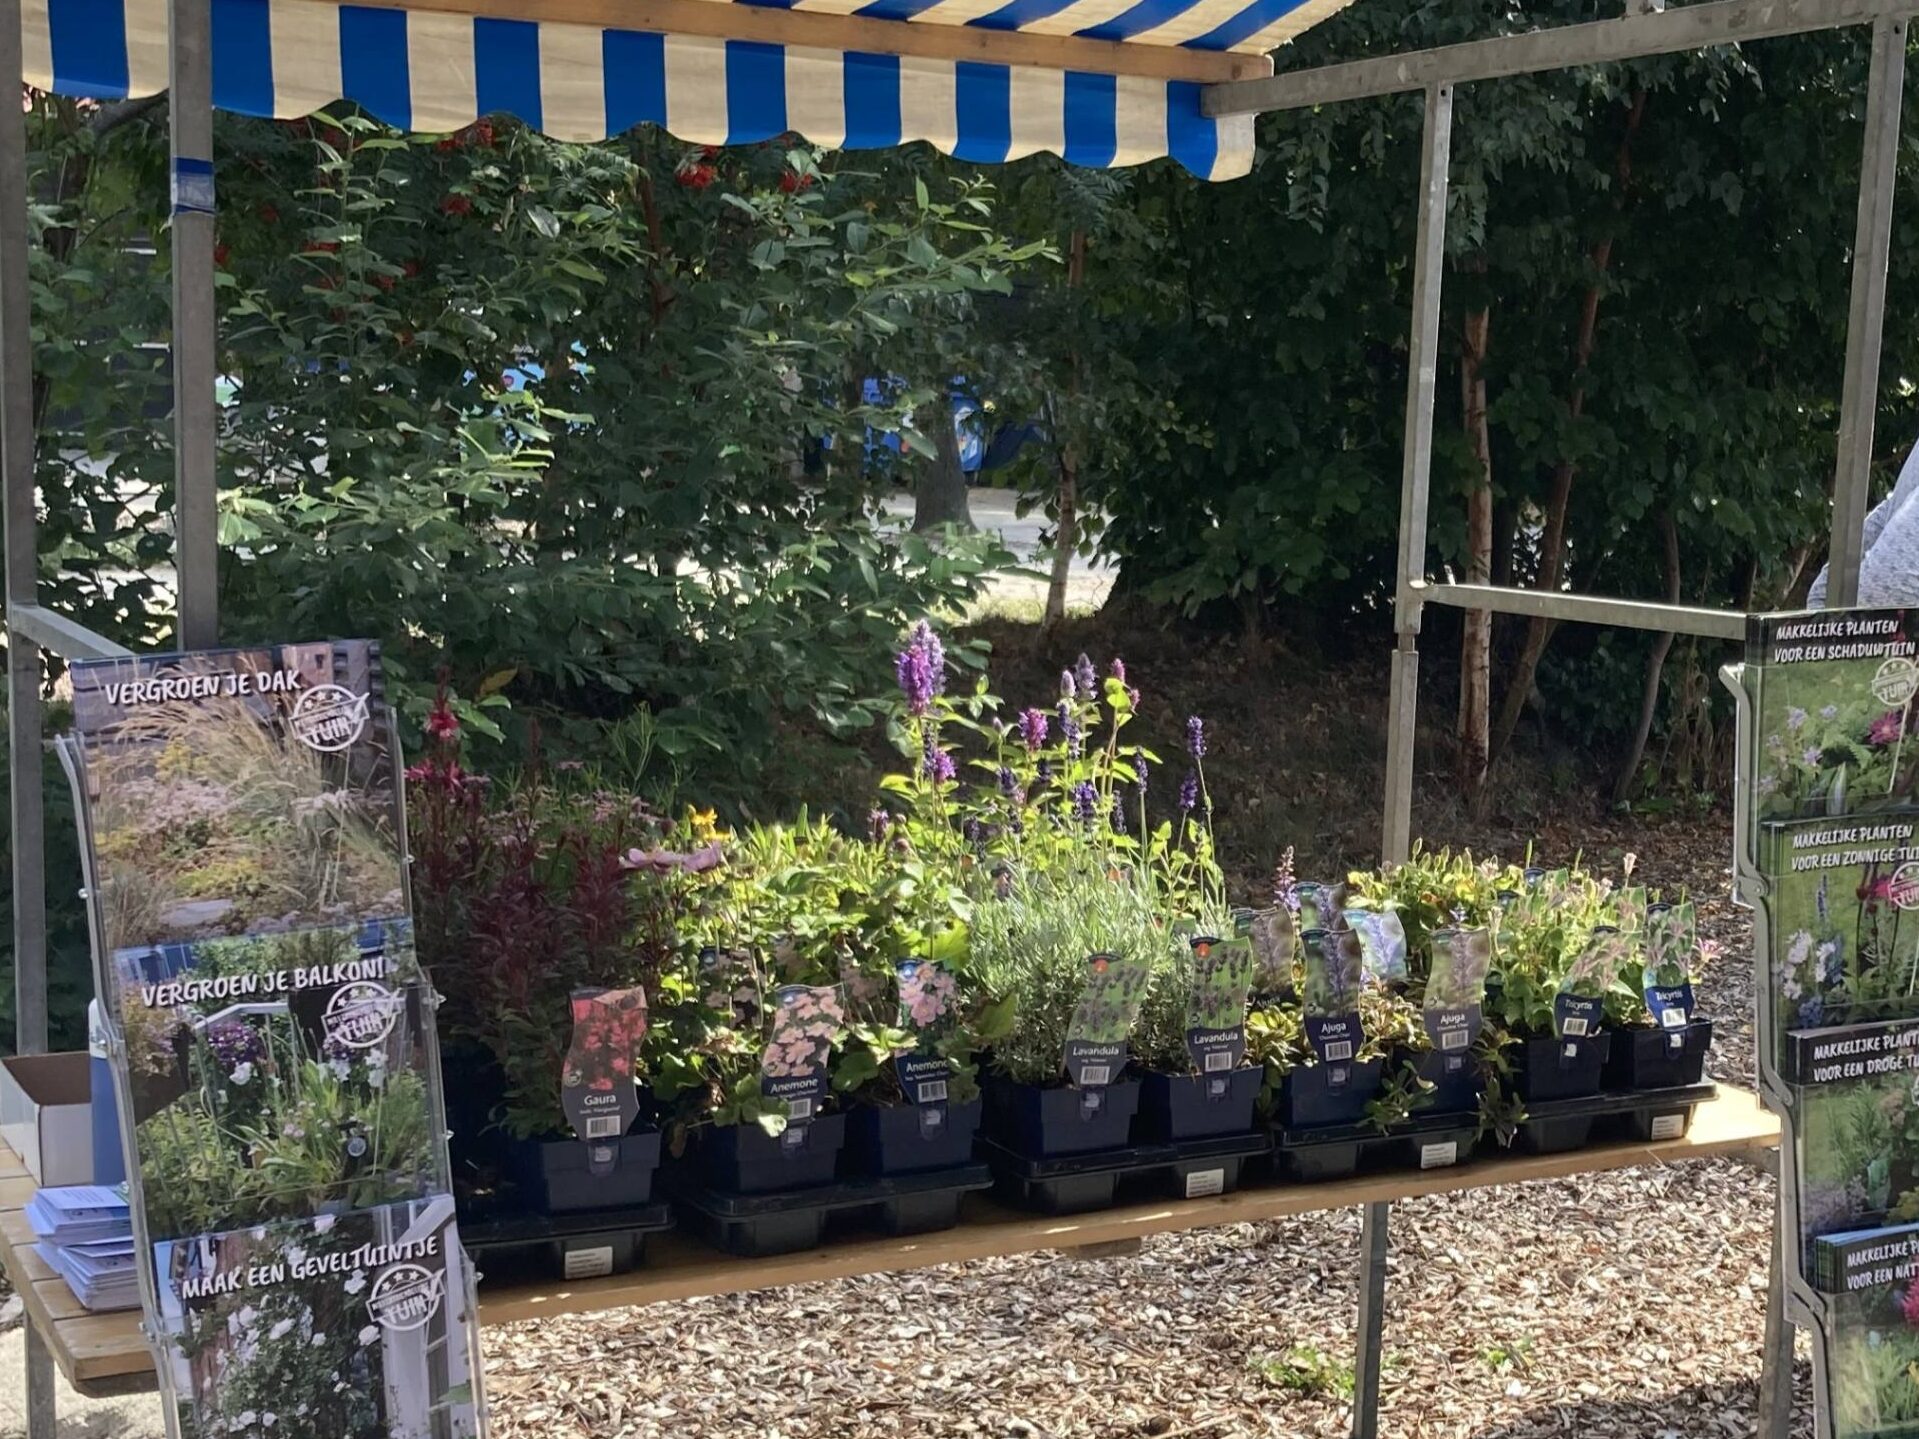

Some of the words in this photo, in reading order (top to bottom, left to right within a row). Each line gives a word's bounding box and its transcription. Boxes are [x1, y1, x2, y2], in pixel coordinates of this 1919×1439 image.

[1776, 622, 1845, 640] MAKKELIJKE
[1846, 620, 1899, 636] PLANTEN
[1774, 647, 1803, 663] VOOR
[1804, 645, 1826, 660] EEN
[1828, 641, 1916, 660] SCHADUWTUIN
[105, 676, 220, 705] VERGROEN
[226, 673, 250, 696] JE
[257, 670, 302, 692] DAK
[1792, 828, 1857, 849] MAKKELIJKE
[1859, 824, 1914, 841] PLANTEN
[1791, 855, 1819, 871] VOOR
[1820, 852, 1841, 867] EEN
[1842, 847, 1896, 865] ZONNIGE
[141, 974, 258, 1008] VERGROEN
[263, 969, 289, 992] JE
[1321, 1022, 1347, 1035] Ajuga
[1440, 1013, 1466, 1026] Ajuga
[1193, 1031, 1239, 1045] Lavandula
[1814, 1037, 1881, 1061] MAKKELIJKE
[1072, 1046, 1120, 1057] Lavandula
[1813, 1064, 1843, 1083] VOOR
[1843, 1061, 1865, 1078] EEN
[1866, 1055, 1904, 1074] DROGE
[770, 1078, 819, 1094] Anemone
[583, 1094, 617, 1106] Gaura
[1847, 1241, 1908, 1269] MAKKELIJKE
[182, 1265, 243, 1300] MAAK
[247, 1262, 285, 1288] EEN
[291, 1236, 439, 1281] GEVELTUINTJE
[1847, 1271, 1873, 1291] VOOR
[1874, 1267, 1893, 1284] EEN
